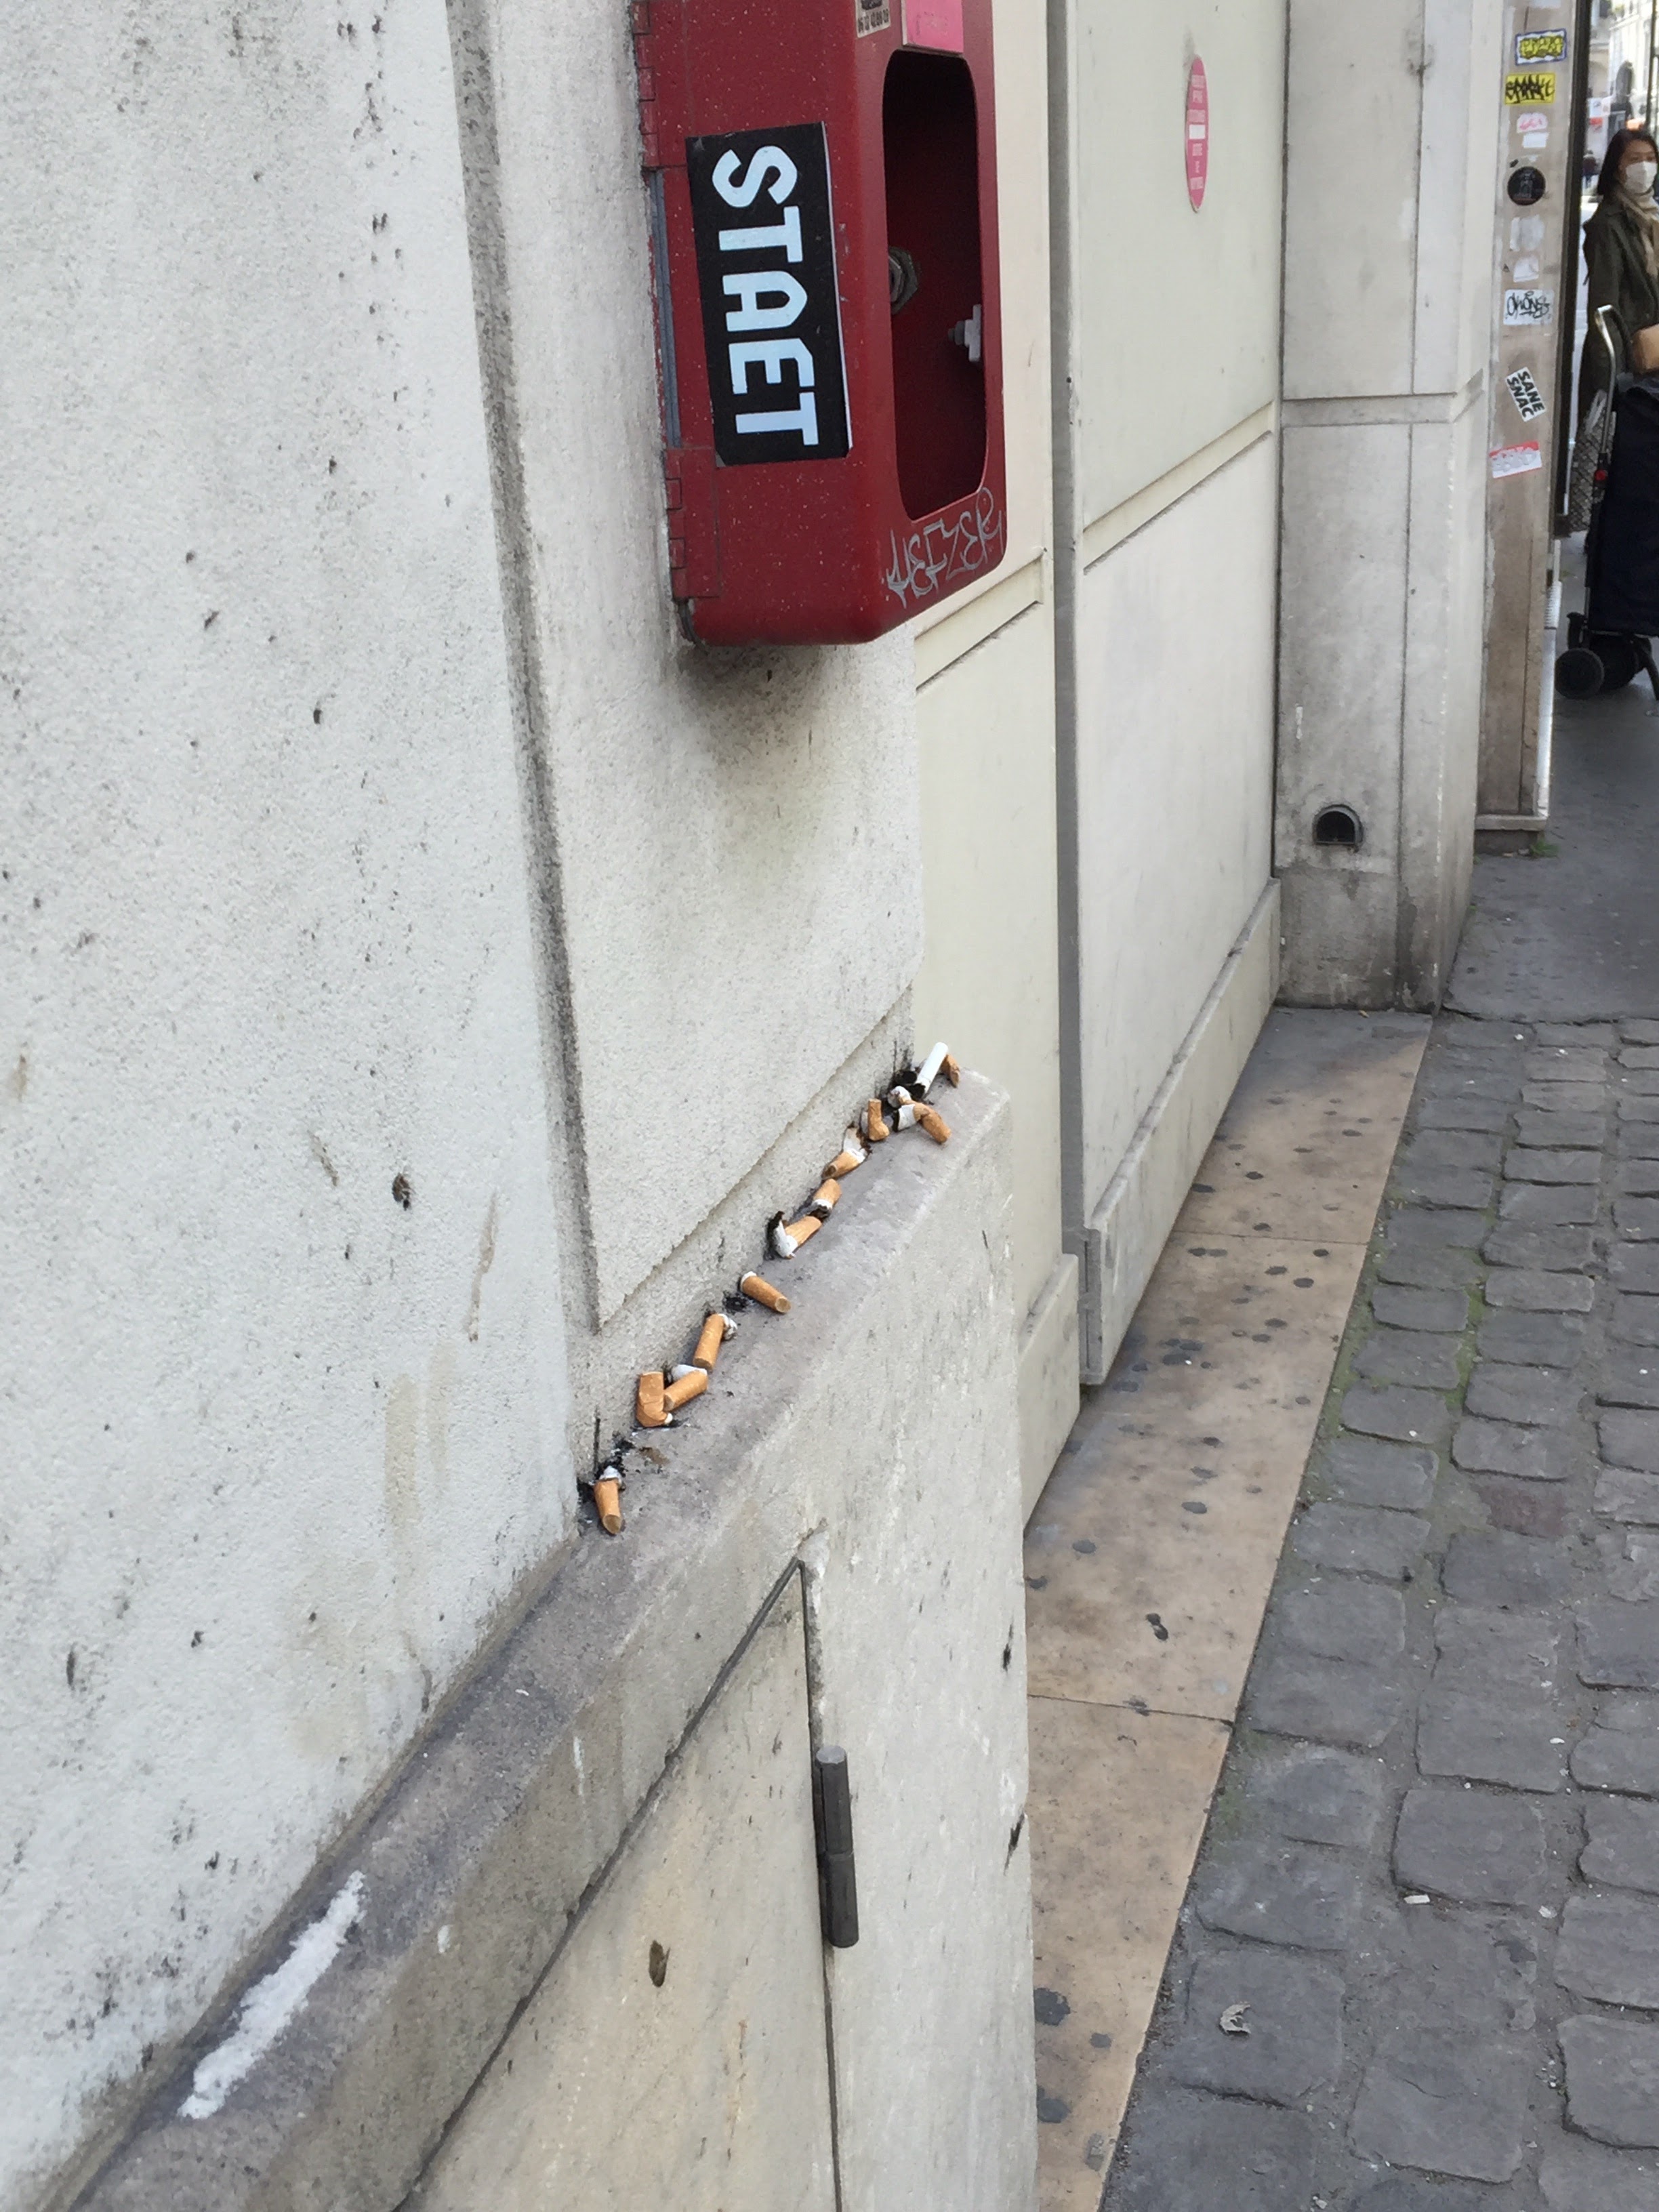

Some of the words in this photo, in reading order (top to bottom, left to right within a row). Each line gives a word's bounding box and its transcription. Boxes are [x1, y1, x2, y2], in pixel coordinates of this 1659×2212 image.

[712, 146, 819, 445] STAET
[1507, 377, 1534, 418] SNAC
[1517, 371, 1545, 412] SANE
